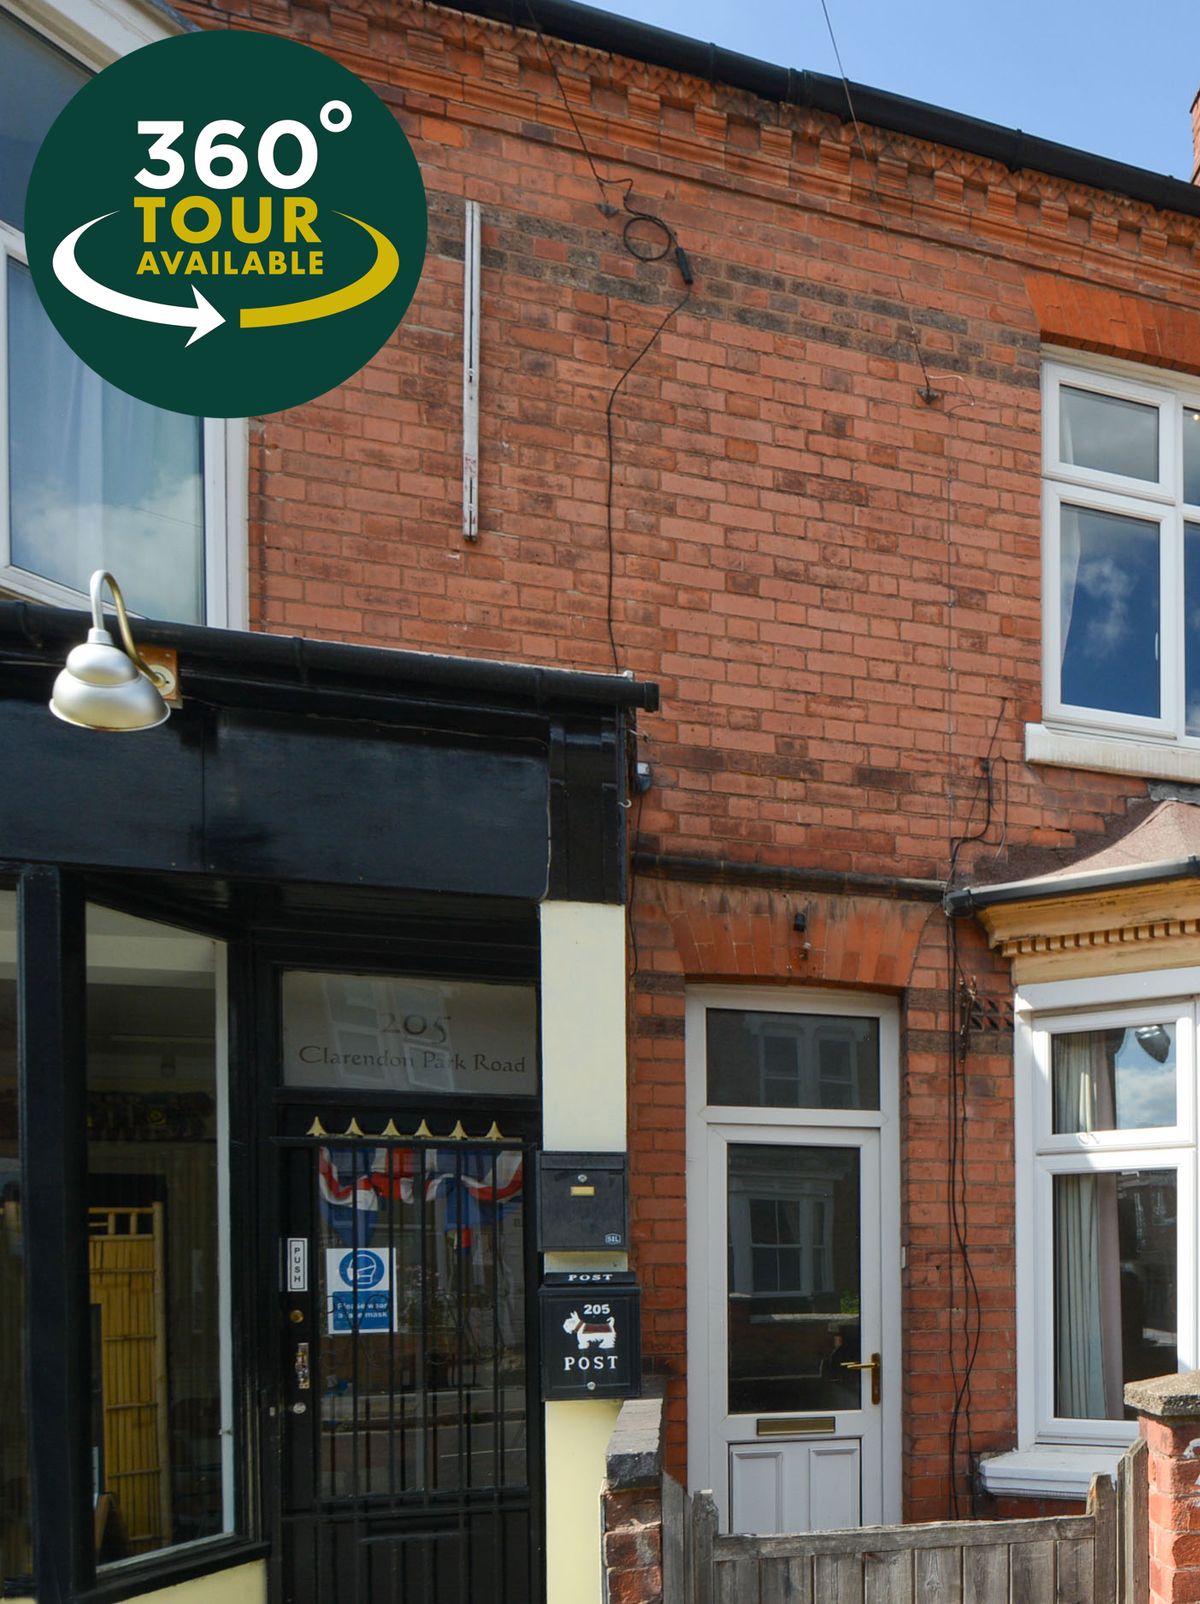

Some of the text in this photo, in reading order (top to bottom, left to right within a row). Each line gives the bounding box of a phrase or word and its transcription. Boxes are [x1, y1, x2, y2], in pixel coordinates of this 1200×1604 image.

[380, 1012, 452, 1045] 205
[299, 1045, 415, 1067] Clarendon
[474, 1053, 526, 1073] Road
[583, 1304, 611, 1315] 205
[564, 1355, 619, 1371] POST
